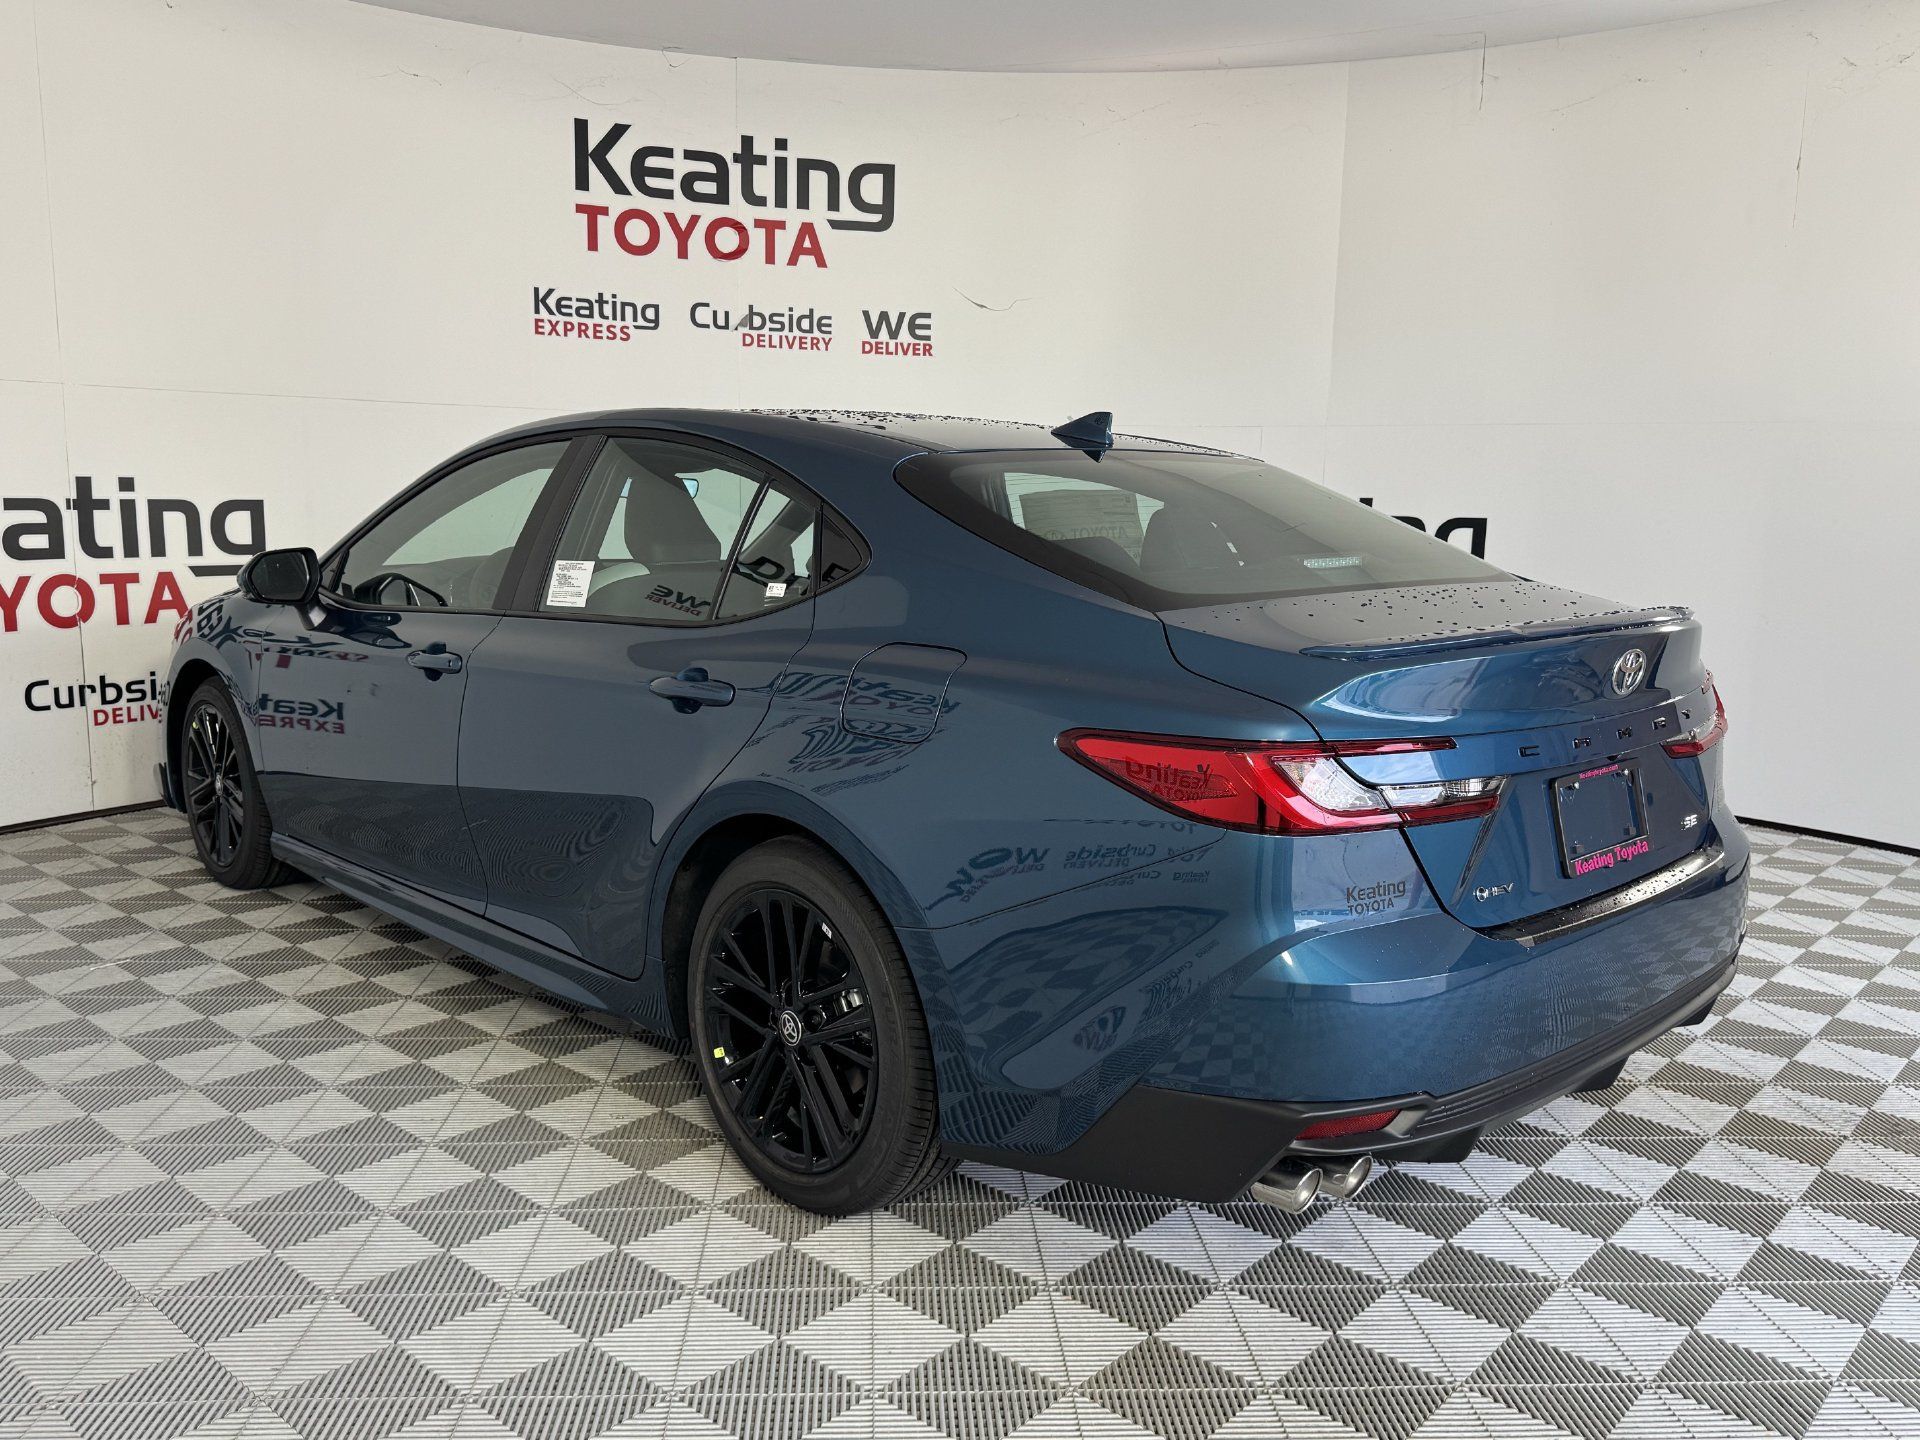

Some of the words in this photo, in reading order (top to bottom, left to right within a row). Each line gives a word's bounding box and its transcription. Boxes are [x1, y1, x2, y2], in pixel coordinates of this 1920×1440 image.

[574, 117, 896, 232] Keating
[575, 203, 828, 268] TOYOTA
[533, 286, 660, 331] Keating
[690, 302, 832, 335] Cubside
[534, 318, 631, 342] EXPRESS
[861, 309, 932, 341] WE
[742, 332, 833, 352] DELIVERY
[861, 340, 933, 357] DELIVER
[0, 571, 190, 633] YOTA
[1575, 852, 1614, 875] Keating
[1614, 840, 1650, 861] Toyota
[1346, 880, 1406, 904] Keating
[1347, 897, 1395, 917] TOYOTA
